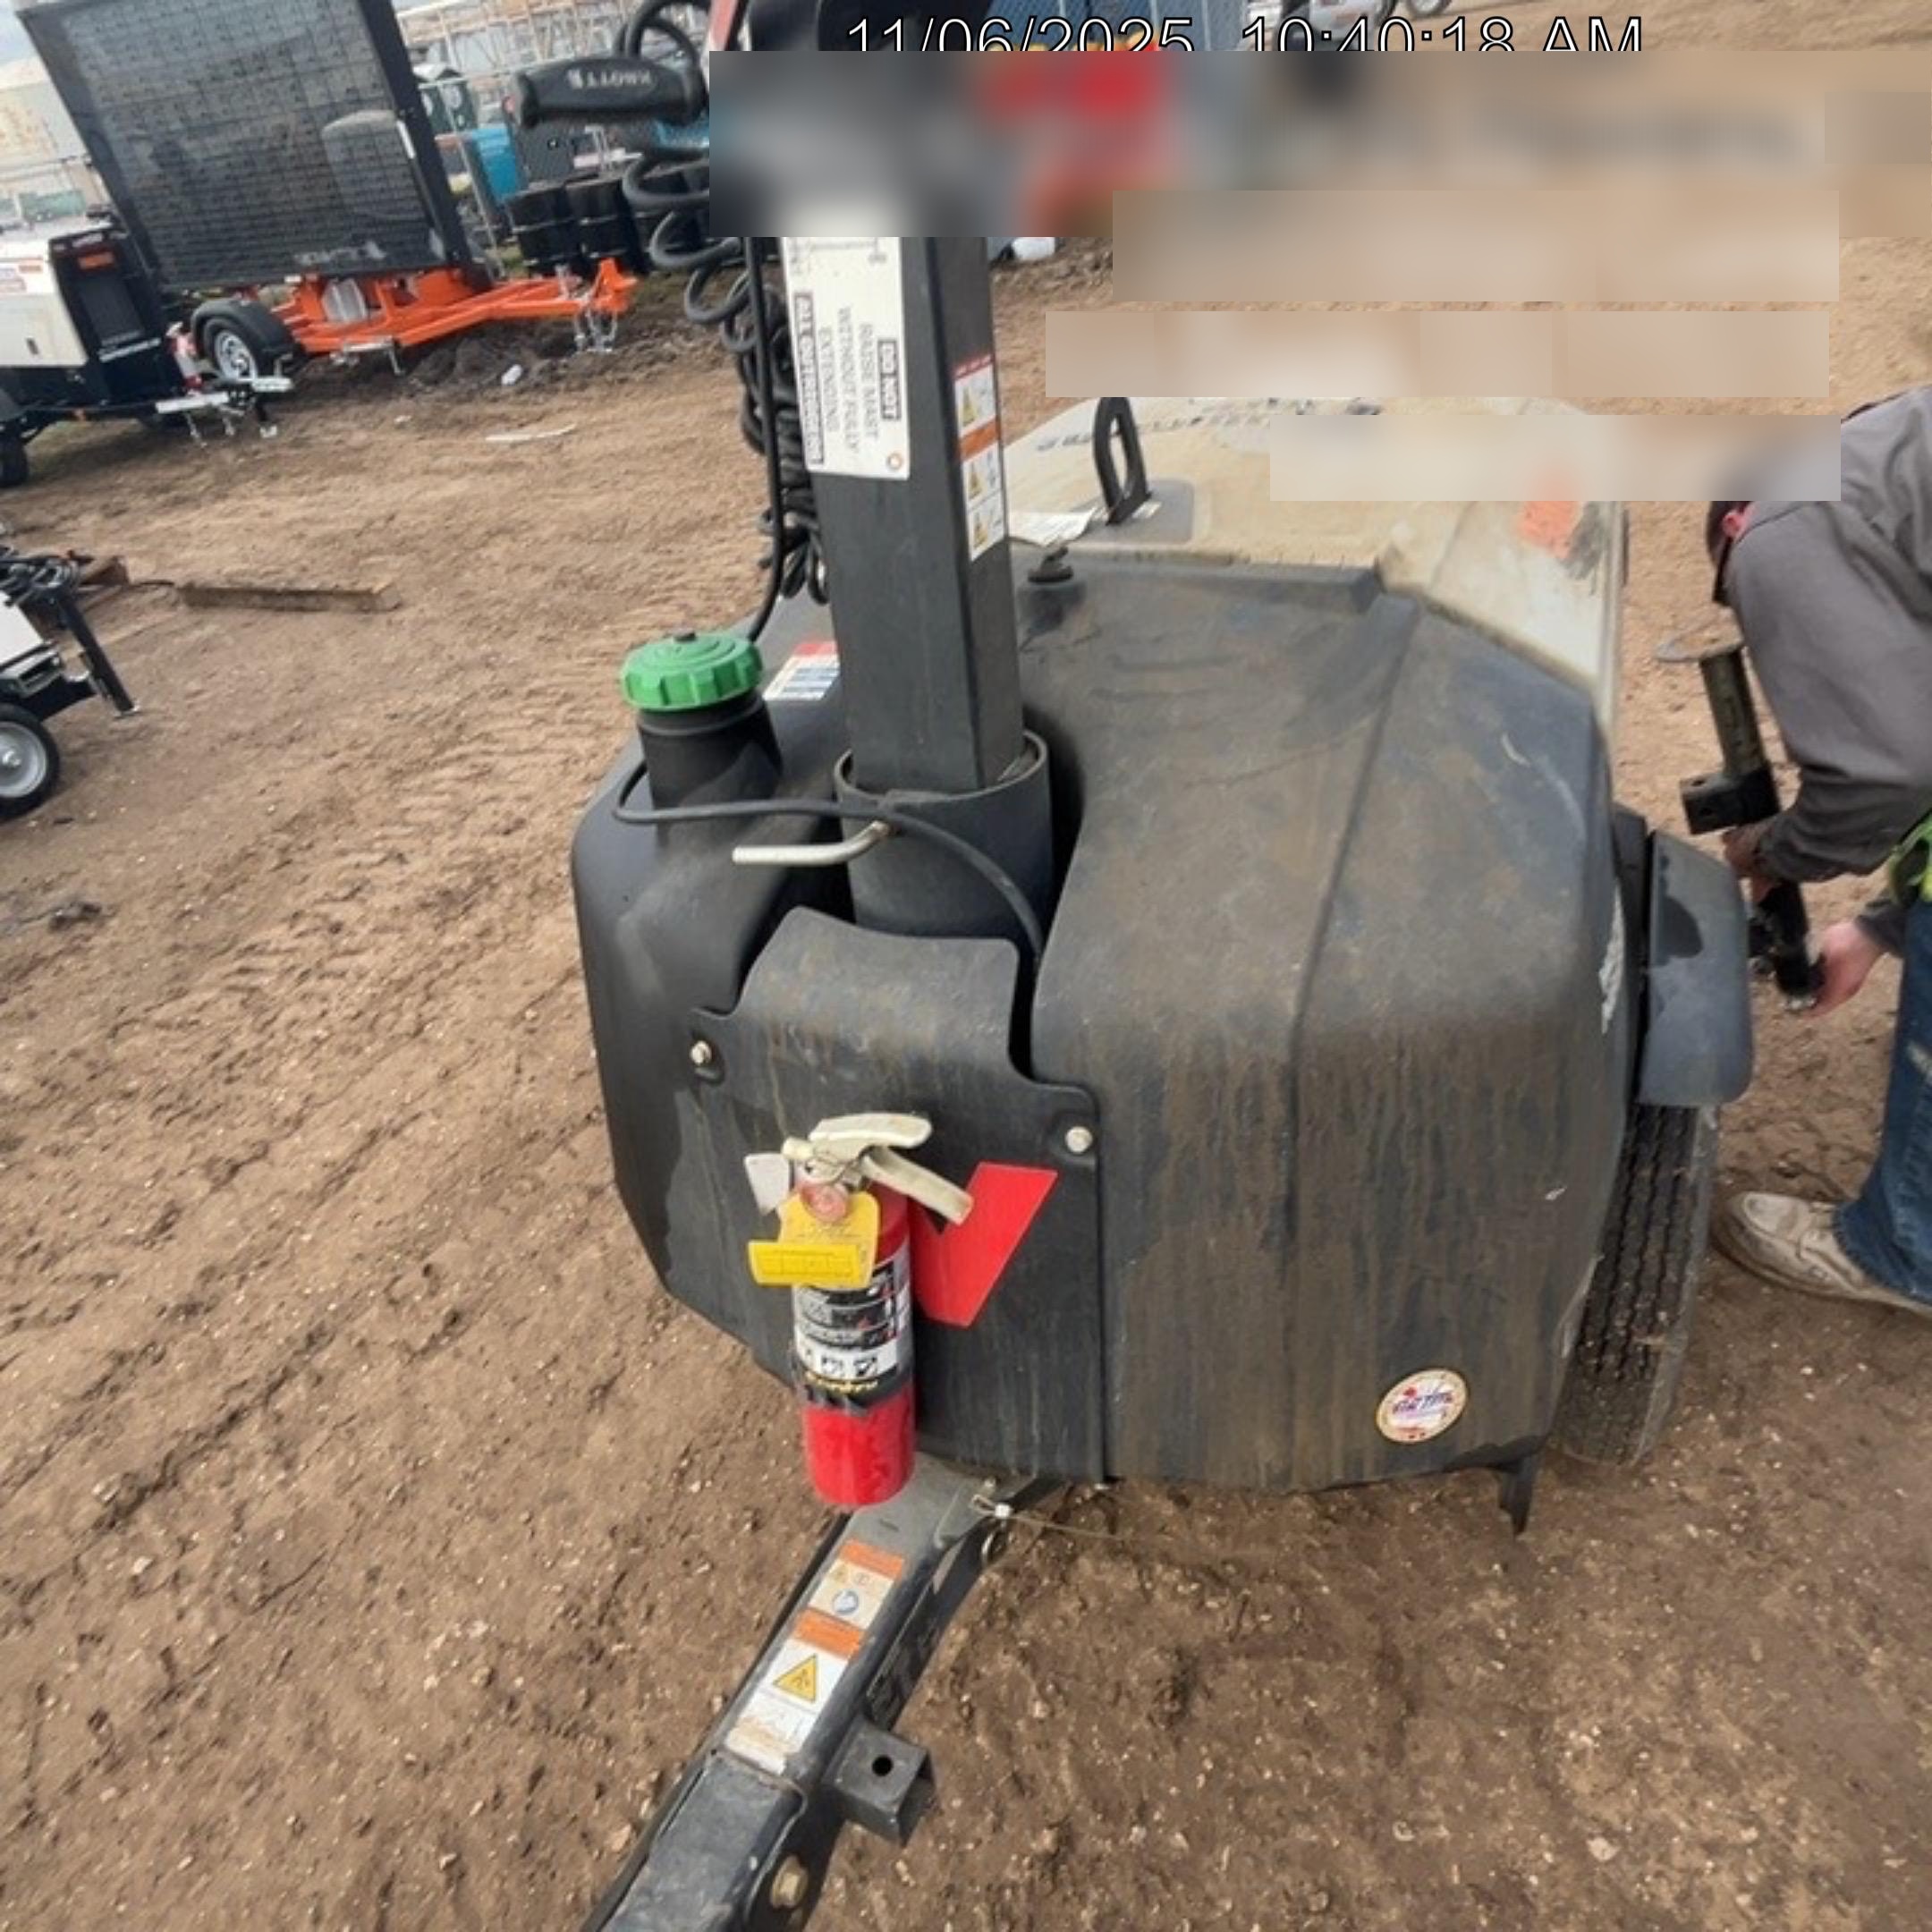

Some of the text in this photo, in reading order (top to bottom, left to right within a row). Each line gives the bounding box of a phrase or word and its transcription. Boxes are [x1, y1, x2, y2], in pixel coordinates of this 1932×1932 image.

[818, 326, 839, 432] EXTENDING
[838, 305, 860, 453] WITHOUT FULLY
[860, 324, 879, 441] RAISE MAST
[881, 342, 899, 418] DO NOT
